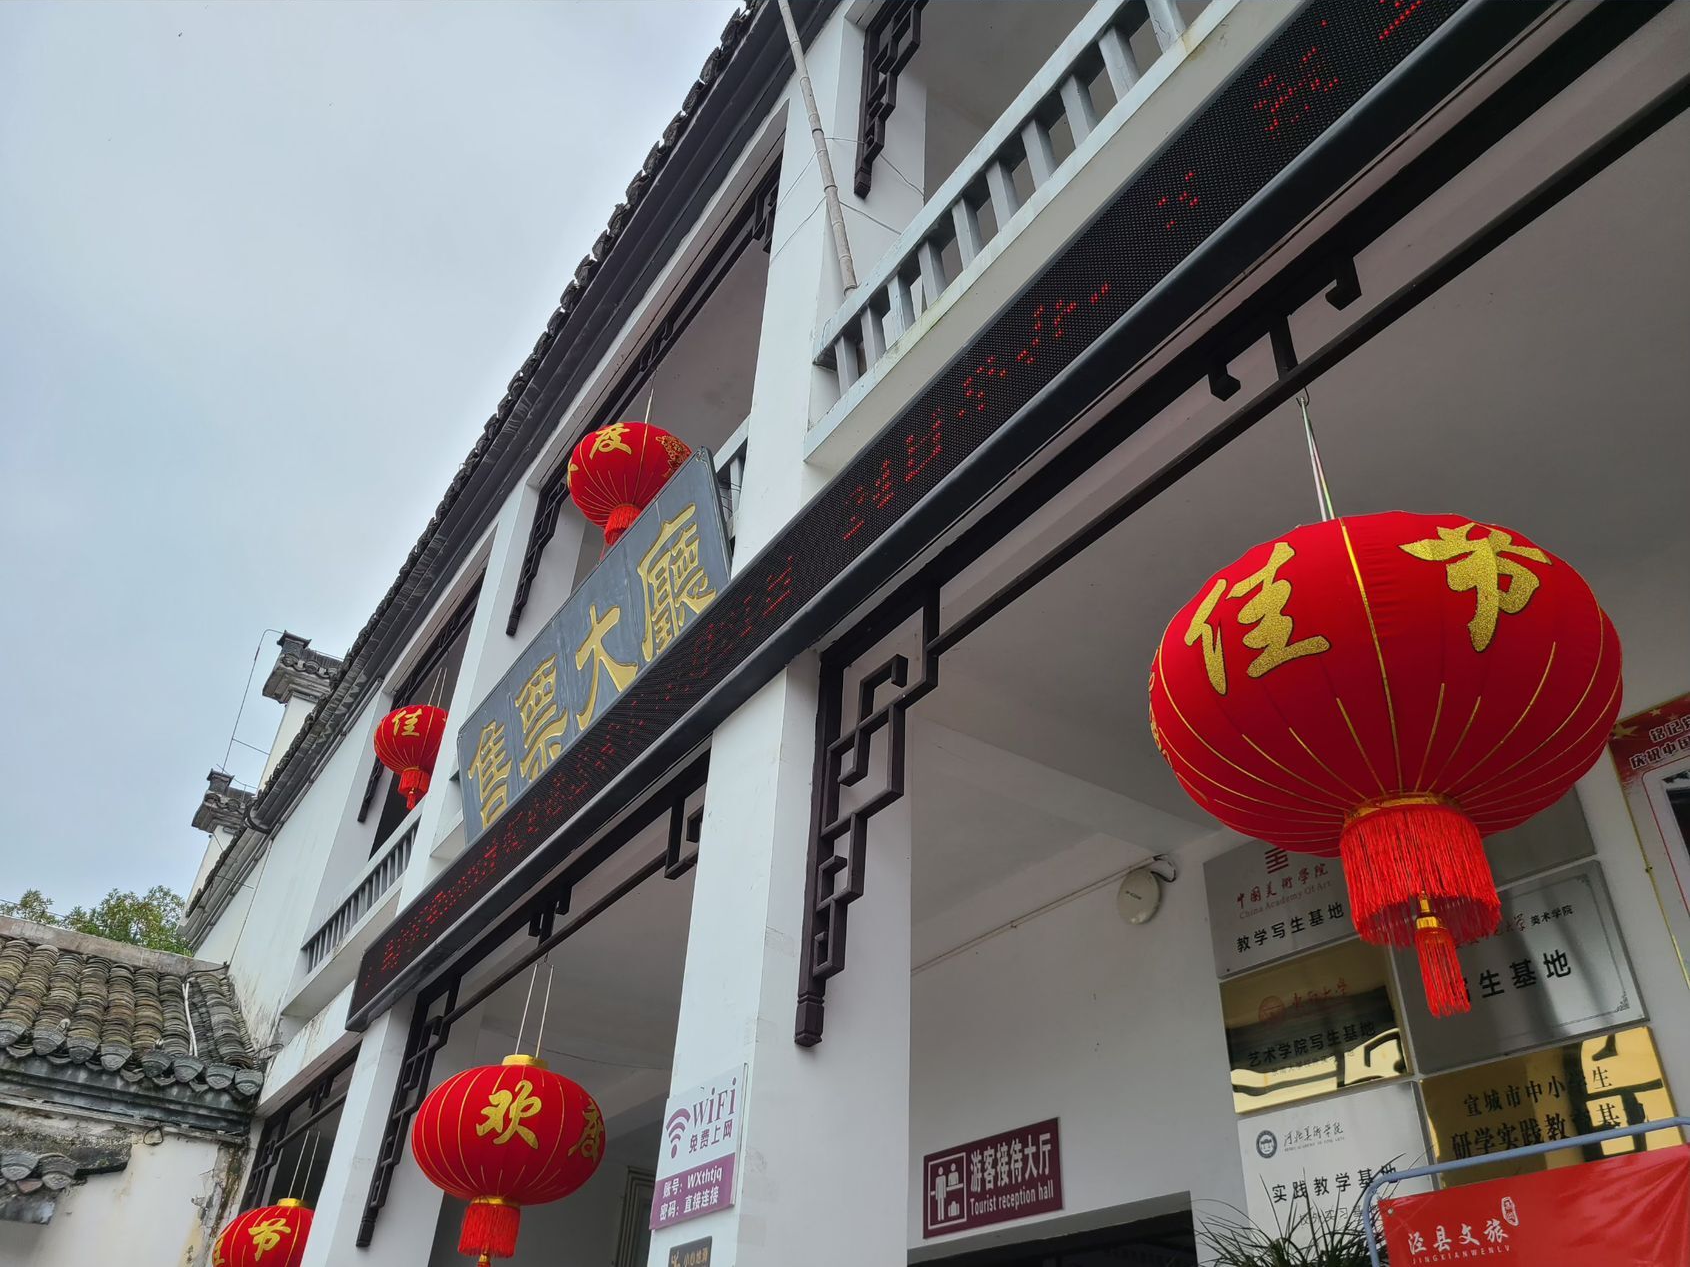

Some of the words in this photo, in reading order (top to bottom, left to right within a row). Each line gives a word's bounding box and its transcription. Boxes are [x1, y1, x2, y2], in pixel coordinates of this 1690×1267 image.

[392, 708, 423, 736] 佳
[1236, 902, 1344, 953] 教学写生基地
[1239, 907, 1263, 920] China
[1463, 949, 1572, 1003] 生基地
[1248, 1020, 1376, 1067] 艺术学院写生基地
[693, 1077, 737, 1129] WiFi
[688, 1119, 733, 1154] 免费上网
[1451, 1102, 1648, 1161] 研学实践教基
[970, 1133, 1051, 1192] 游客接待大厅
[970, 1194, 997, 1217] Tourist
[999, 1186, 1035, 1215] reception
[1038, 1180, 1054, 1202] hall
[1408, 1220, 1508, 1255] 泾县文旅
